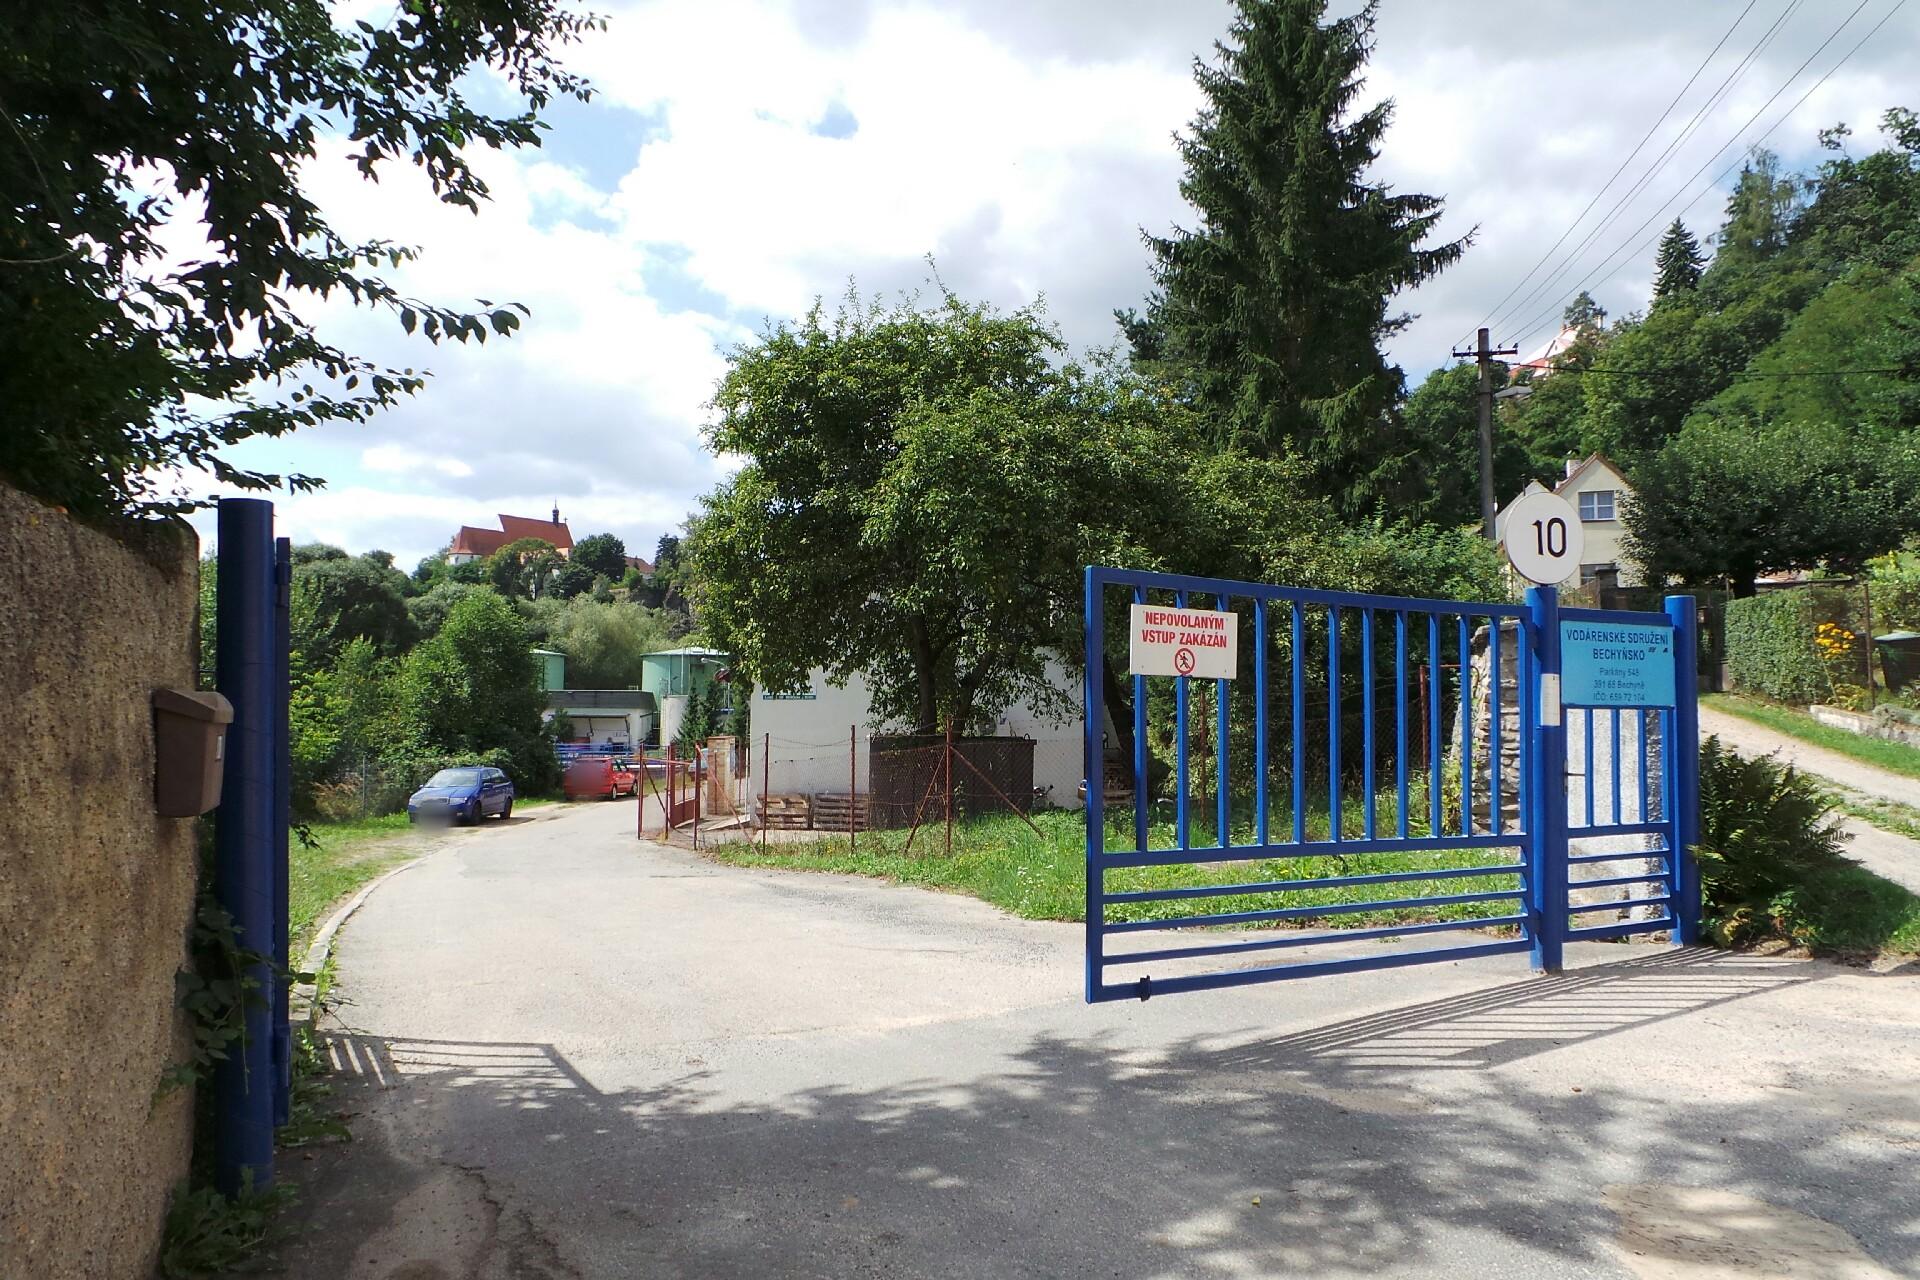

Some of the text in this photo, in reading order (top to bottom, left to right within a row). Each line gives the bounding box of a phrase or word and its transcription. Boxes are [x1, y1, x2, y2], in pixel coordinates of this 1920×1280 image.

[1532, 518, 1567, 558] 10
[1145, 612, 1224, 630] NEPOVOLANÝM
[1142, 630, 1227, 648] VSTUP ZAKÁZÁN
[1567, 628, 1669, 645] VODÁRENSKÉ SDRUŽENÍ
[1593, 647, 1645, 660] BECHYŇSKO
